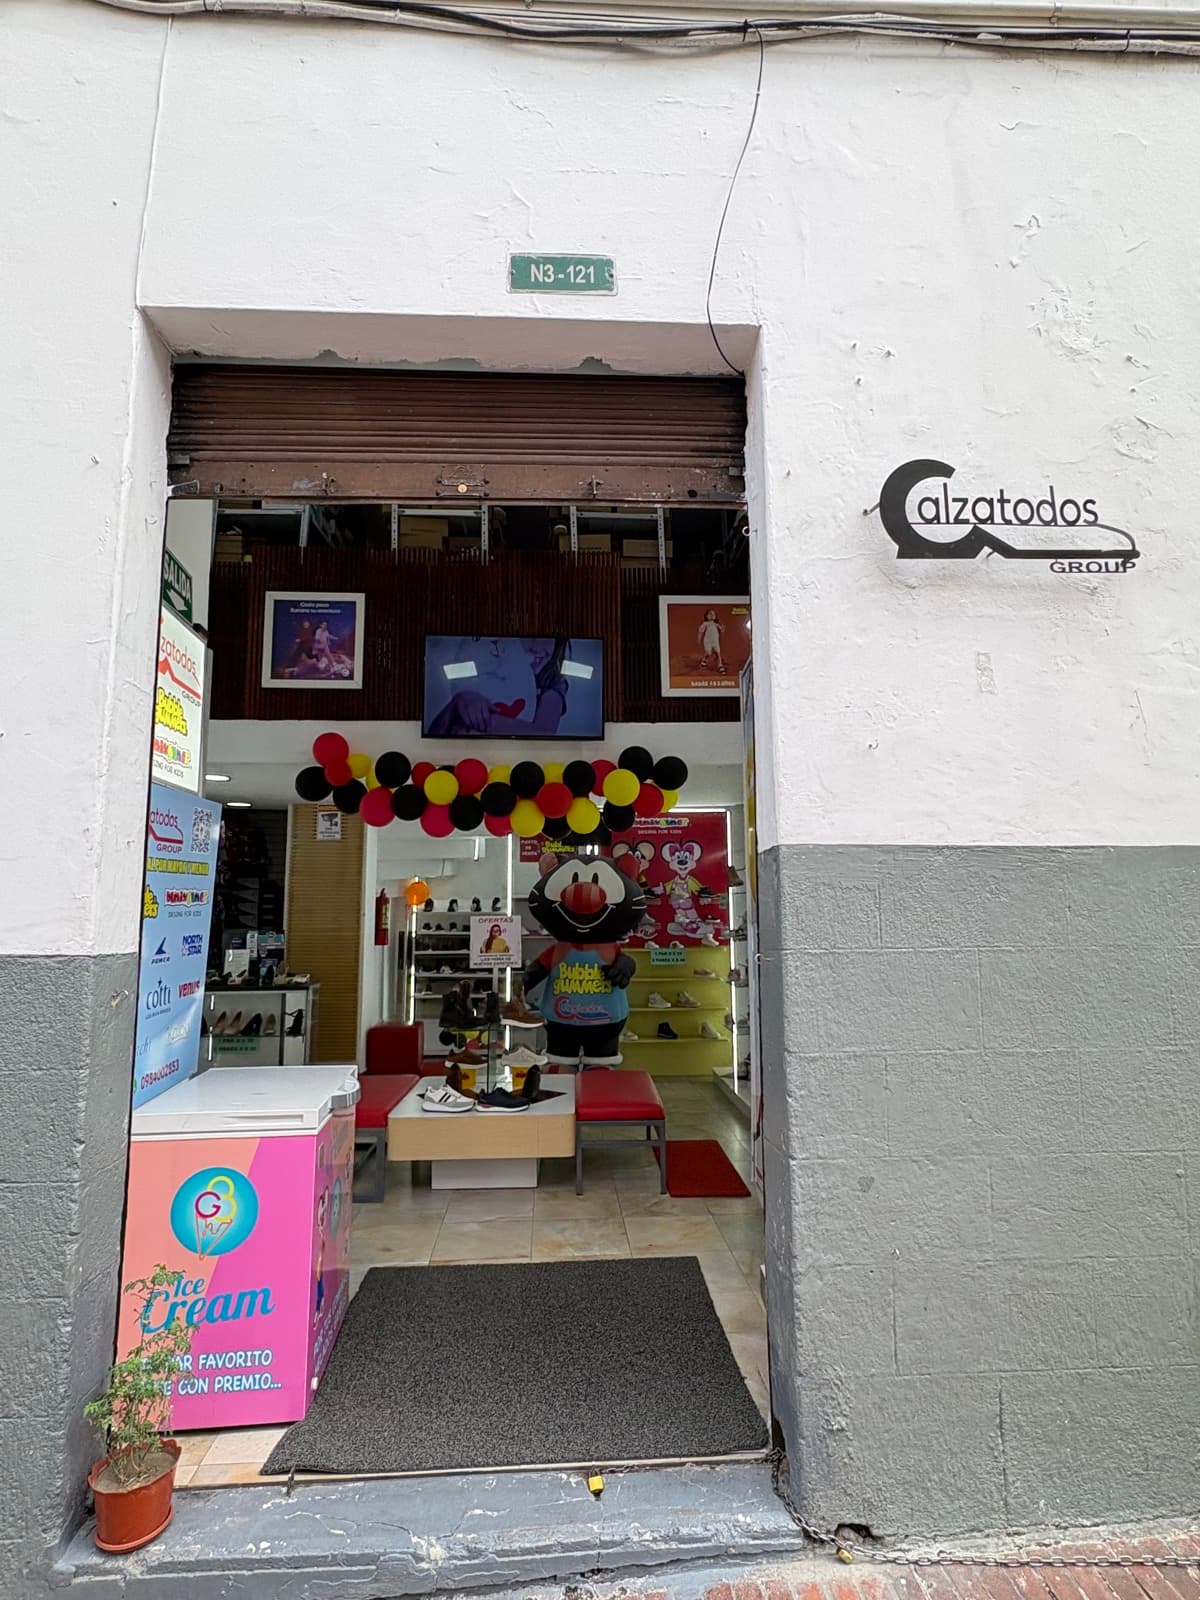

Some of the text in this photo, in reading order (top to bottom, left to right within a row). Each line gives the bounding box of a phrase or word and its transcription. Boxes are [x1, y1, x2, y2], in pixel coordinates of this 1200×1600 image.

[879, 458, 1100, 560] Calzatodos
[1049, 560, 1137, 574] GROUP
[163, 556, 192, 602] SALIDA
[160, 635, 197, 674] zatodos
[149, 807, 178, 828] atodos
[156, 843, 182, 854] GROUP
[173, 1274, 205, 1298] Ice
[140, 1288, 276, 1334] Cream
[198, 1350, 273, 1369] FAVORITO
[178, 1377, 209, 1395] CON
